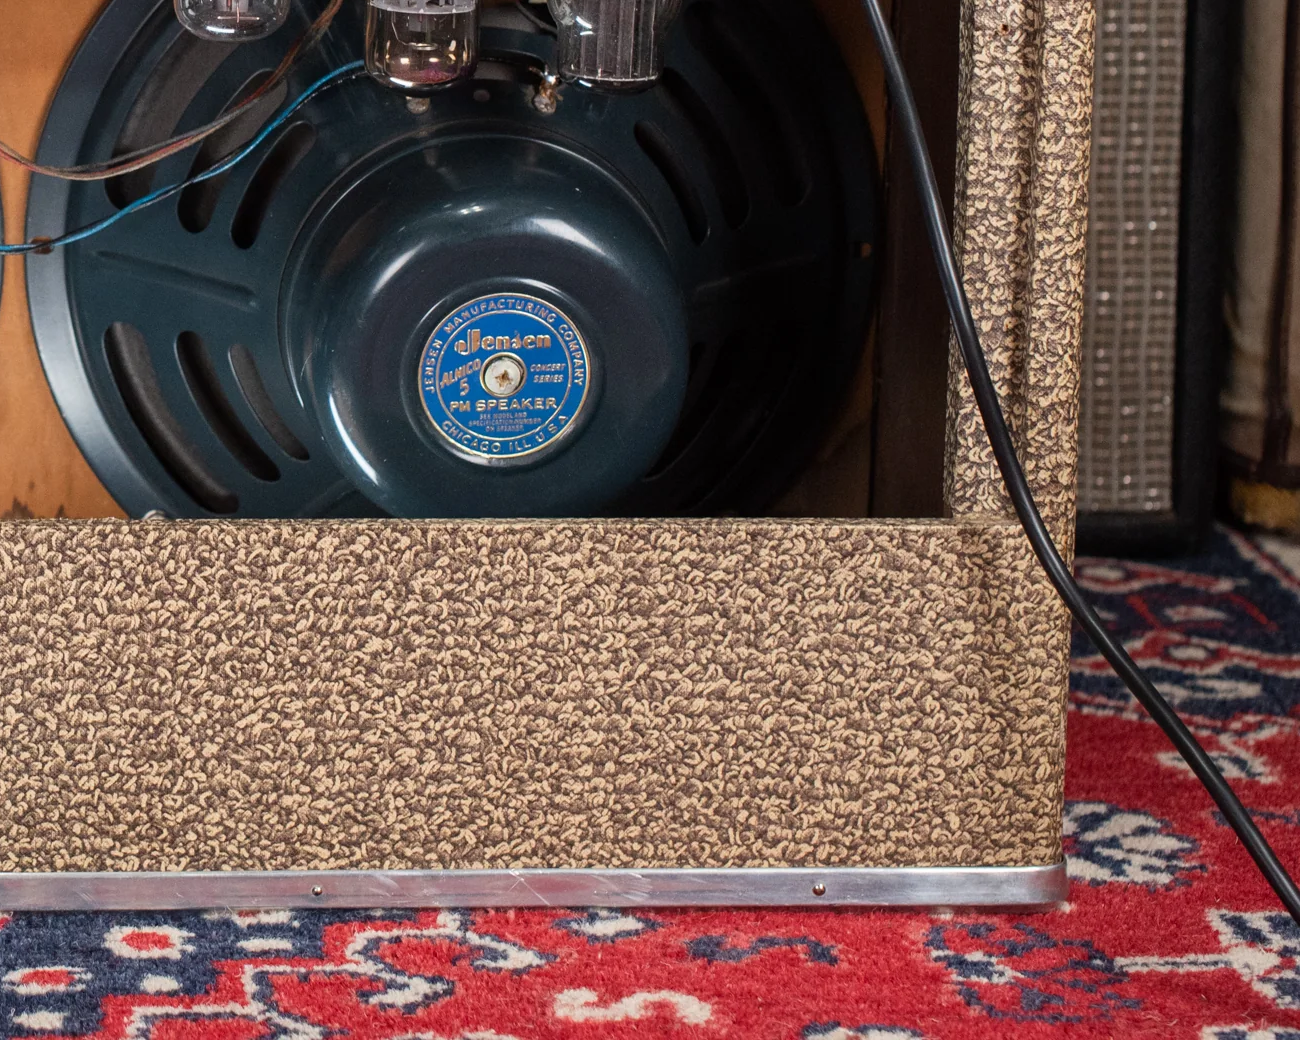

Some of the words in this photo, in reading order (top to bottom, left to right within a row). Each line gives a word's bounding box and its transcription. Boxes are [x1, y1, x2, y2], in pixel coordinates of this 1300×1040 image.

[424, 339, 443, 393] JENSEN
[443, 299, 557, 333] MANUFACTURING
[558, 324, 584, 386] COMPANY
[454, 329, 552, 356] Jensen
[440, 358, 482, 388] ALNICO
[530, 363, 566, 372] CONCERT
[460, 377, 470, 396] 5
[533, 374, 564, 383] SERIES
[450, 400, 471, 412] PM
[475, 397, 558, 412] SPEAKER
